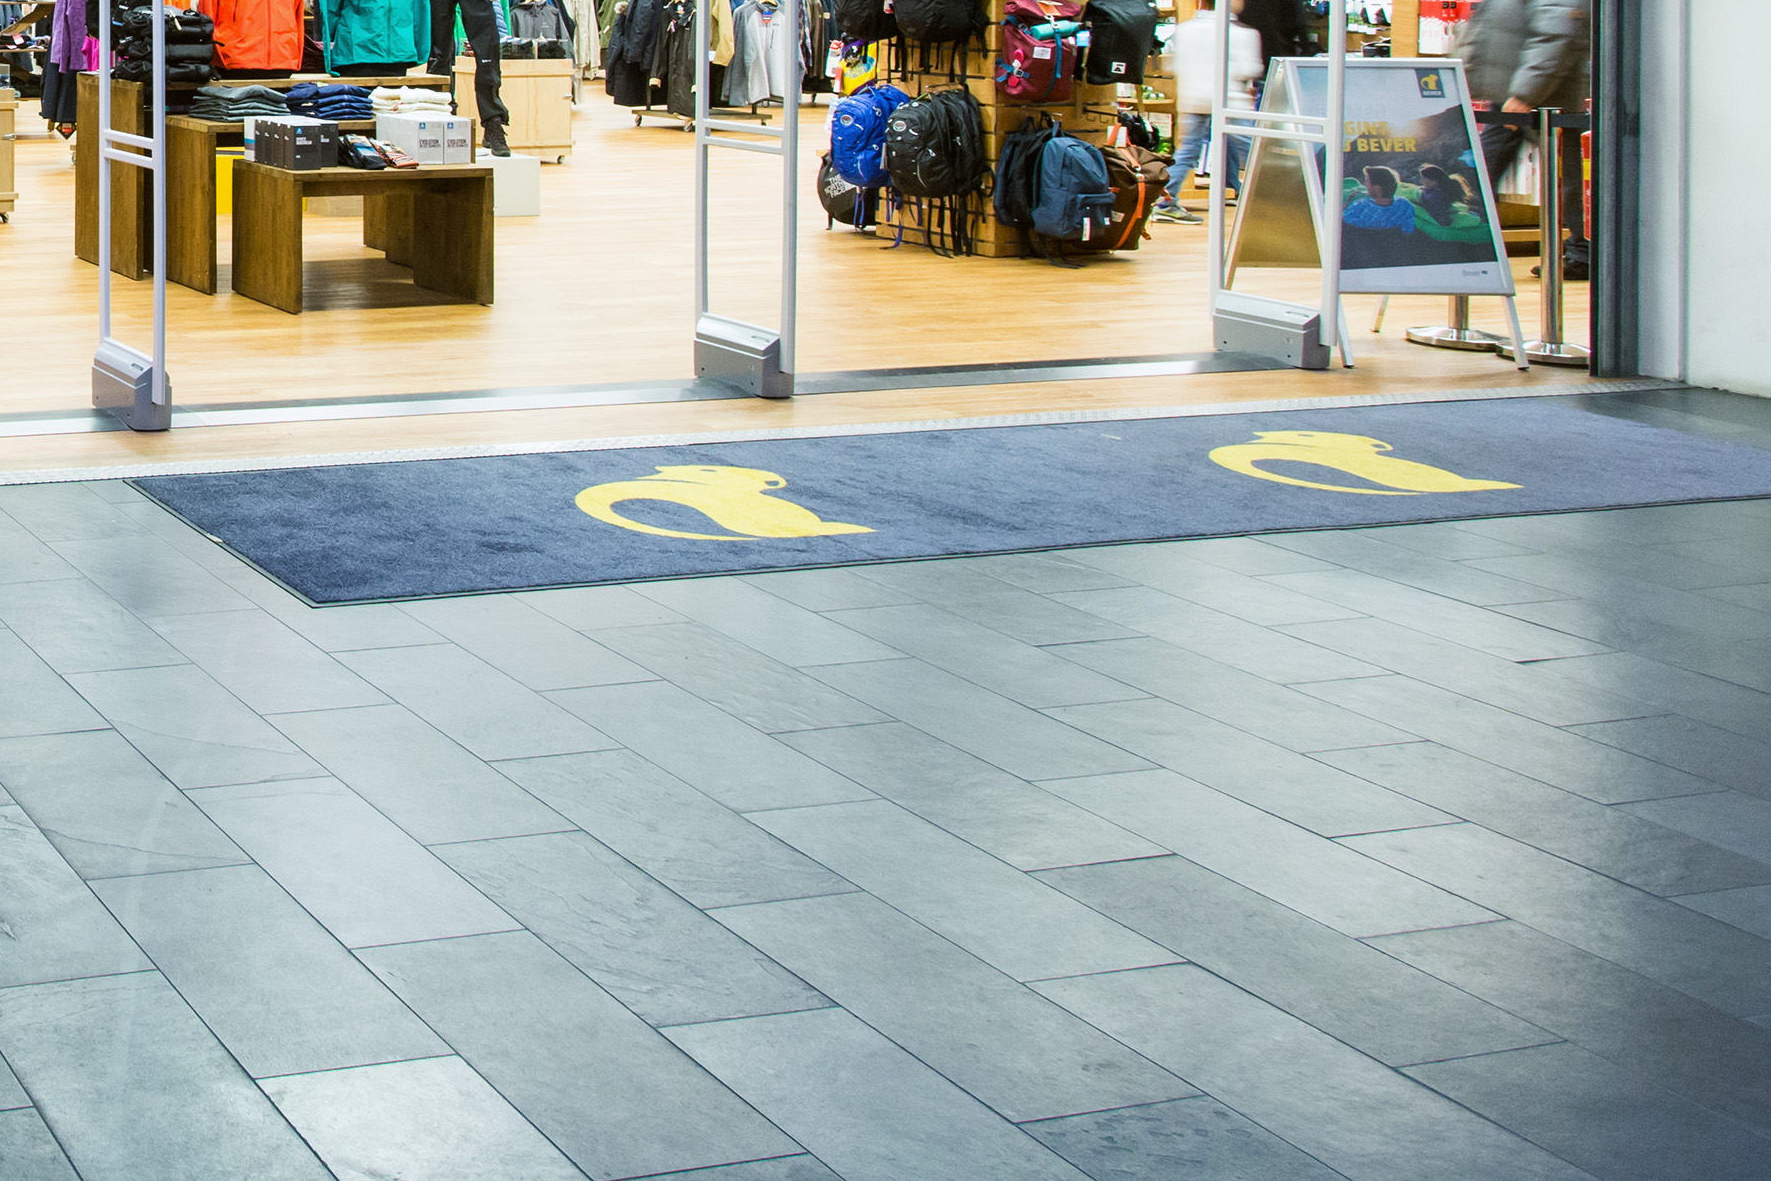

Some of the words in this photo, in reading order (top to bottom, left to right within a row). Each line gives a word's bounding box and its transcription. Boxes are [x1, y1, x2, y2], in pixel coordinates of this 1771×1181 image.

[1344, 121, 1388, 135] GINT
[1356, 137, 1417, 152] BEVER
[828, 174, 843, 184] THE
[830, 187, 846, 198] FACE
